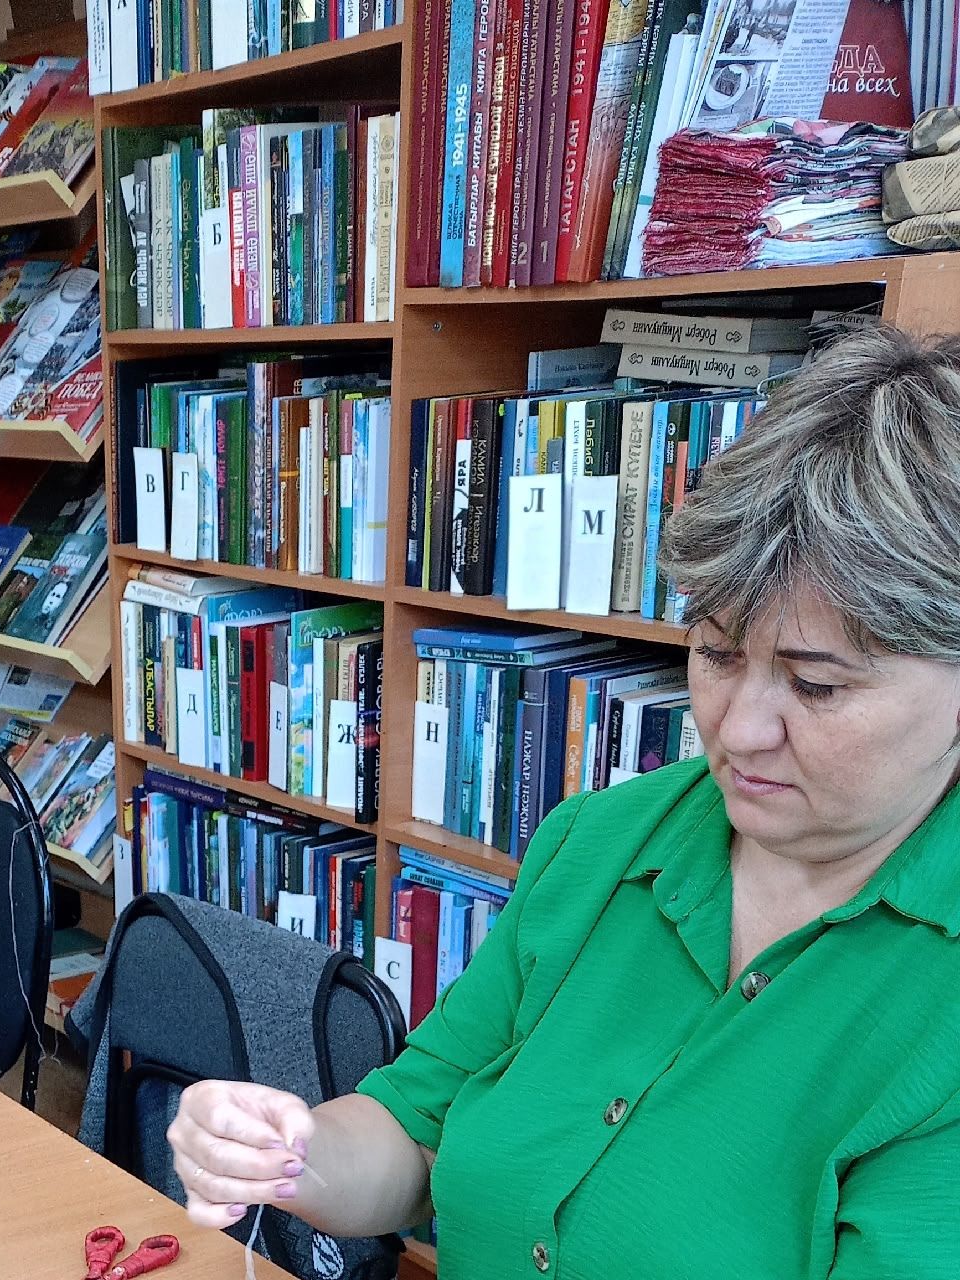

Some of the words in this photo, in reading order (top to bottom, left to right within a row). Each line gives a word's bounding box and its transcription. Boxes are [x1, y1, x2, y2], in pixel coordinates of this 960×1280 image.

[509, 20, 520, 70] ПОБЕДОЙ
[639, 24, 651, 67] КӘРИМ
[647, 23, 660, 65] КӘРИМ
[476, 48, 487, 92] КНИГА
[828, 44, 886, 76] ДА
[492, 57, 504, 102] ПОБЕДА
[855, 76, 902, 96] всех
[561, 120, 580, 234] ТАТАРСТАН
[572, 1, 590, 95] 1941-194
[627, 103, 637, 144] ФАТИХ
[636, 100, 647, 141] ФАТИХ
[473, 113, 483, 168] КИТАБЫ
[515, 157, 523, 189] ТРУДА
[617, 147, 629, 187] КАРИМ
[626, 144, 637, 185] КАРИМ
[468, 175, 479, 246] БАТЫРЛАР
[513, 193, 521, 230] ГЕРОЕВ
[137, 232, 147, 247] АК
[212, 223, 222, 246] Б
[511, 234, 519, 265] КНИГА
[519, 243, 528, 265] 2
[137, 250, 147, 307] ЧӘЧӘКЛӘР
[632, 321, 683, 343] Миңнуллин
[686, 324, 717, 345] Роберт
[651, 355, 701, 376] Миңнуллин
[704, 357, 736, 379] Роберт
[458, 461, 467, 487] ЯРА
[476, 439, 487, 485] КАМИЛ
[146, 473, 156, 494] В
[180, 471, 190, 492] Г
[523, 486, 546, 514] Л
[622, 483, 636, 539] СИРАТ
[582, 508, 604, 536] М
[144, 657, 155, 732] АЛБАСТЫЛАР
[186, 693, 198, 715] Д
[337, 723, 357, 745] Ж
[425, 720, 438, 744] Н
[290, 917, 303, 936] И
[386, 961, 400, 979] С
